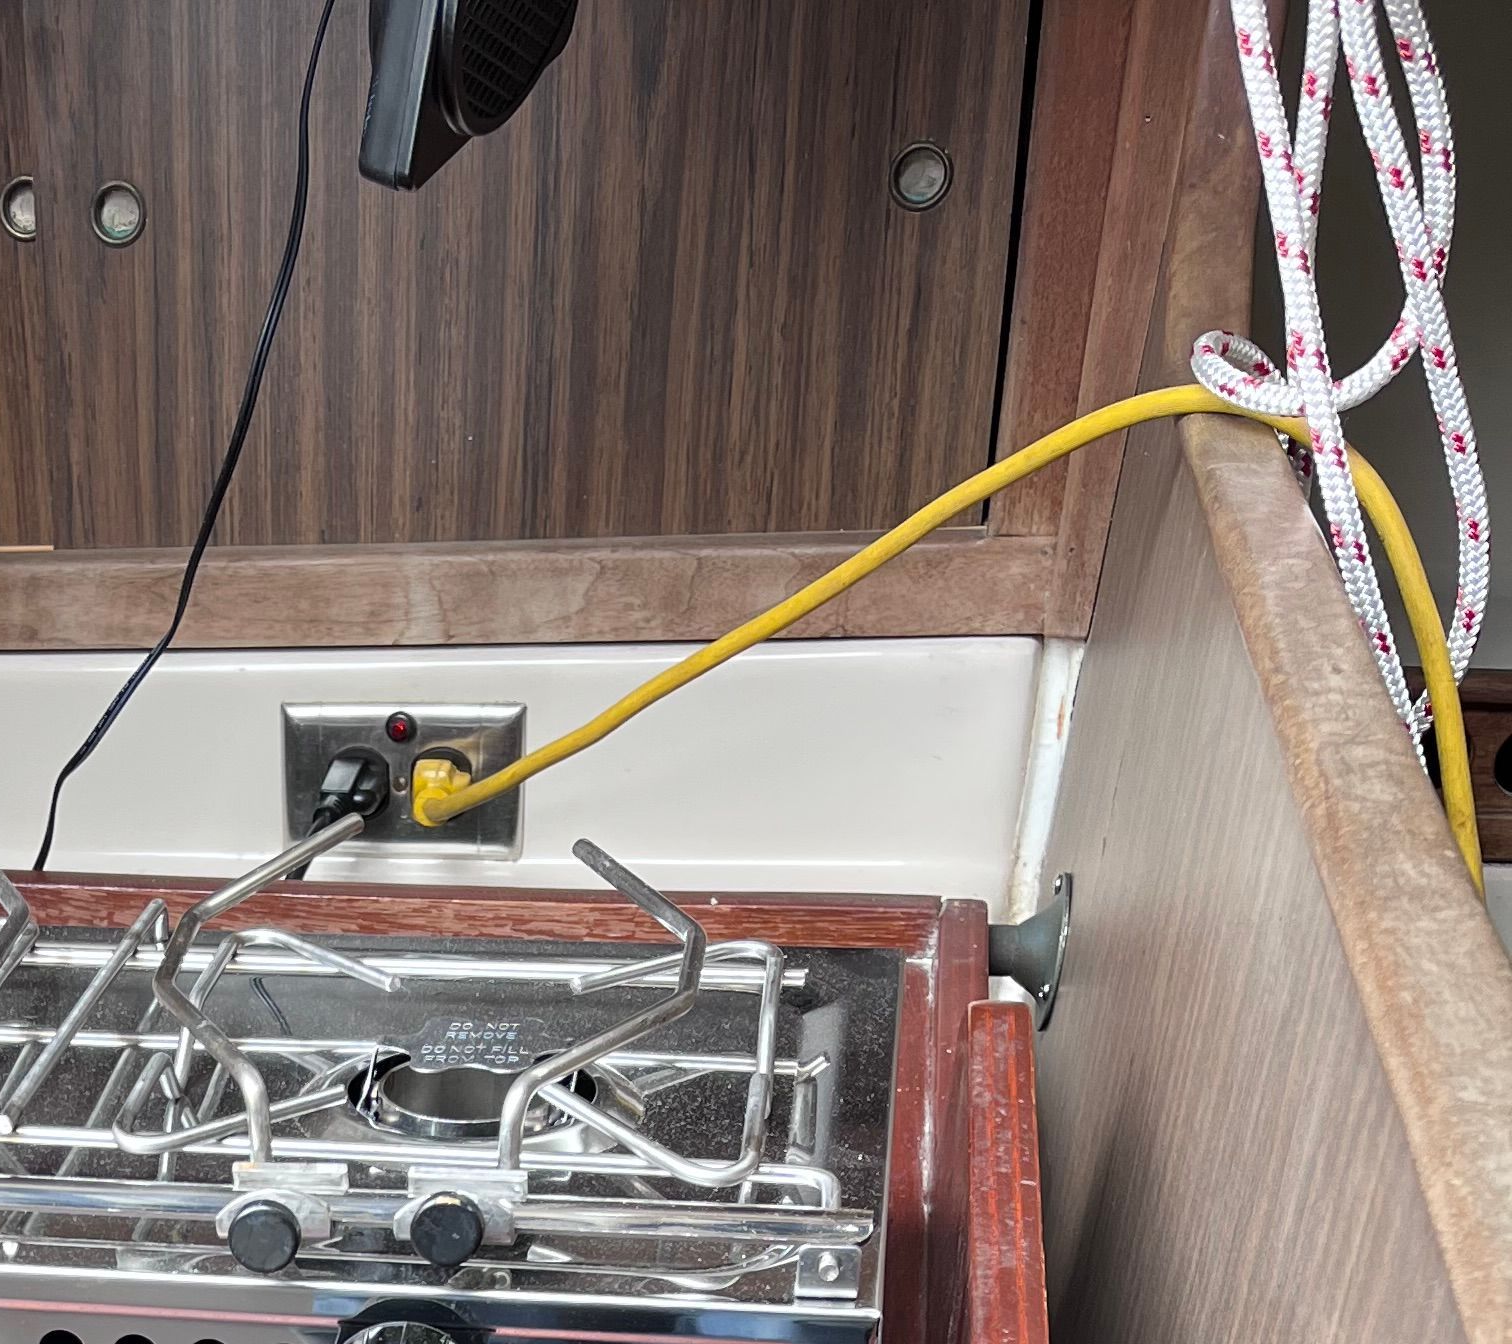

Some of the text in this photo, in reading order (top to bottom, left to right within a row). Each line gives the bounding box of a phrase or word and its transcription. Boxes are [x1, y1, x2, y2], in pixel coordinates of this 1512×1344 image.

[449, 1022, 521, 1031] DO NOT
[445, 1031, 518, 1040] REMOVE
[421, 1045, 446, 1054] DO
[490, 1045, 529, 1055] FILL
[423, 1055, 520, 1064] FROM TOP
